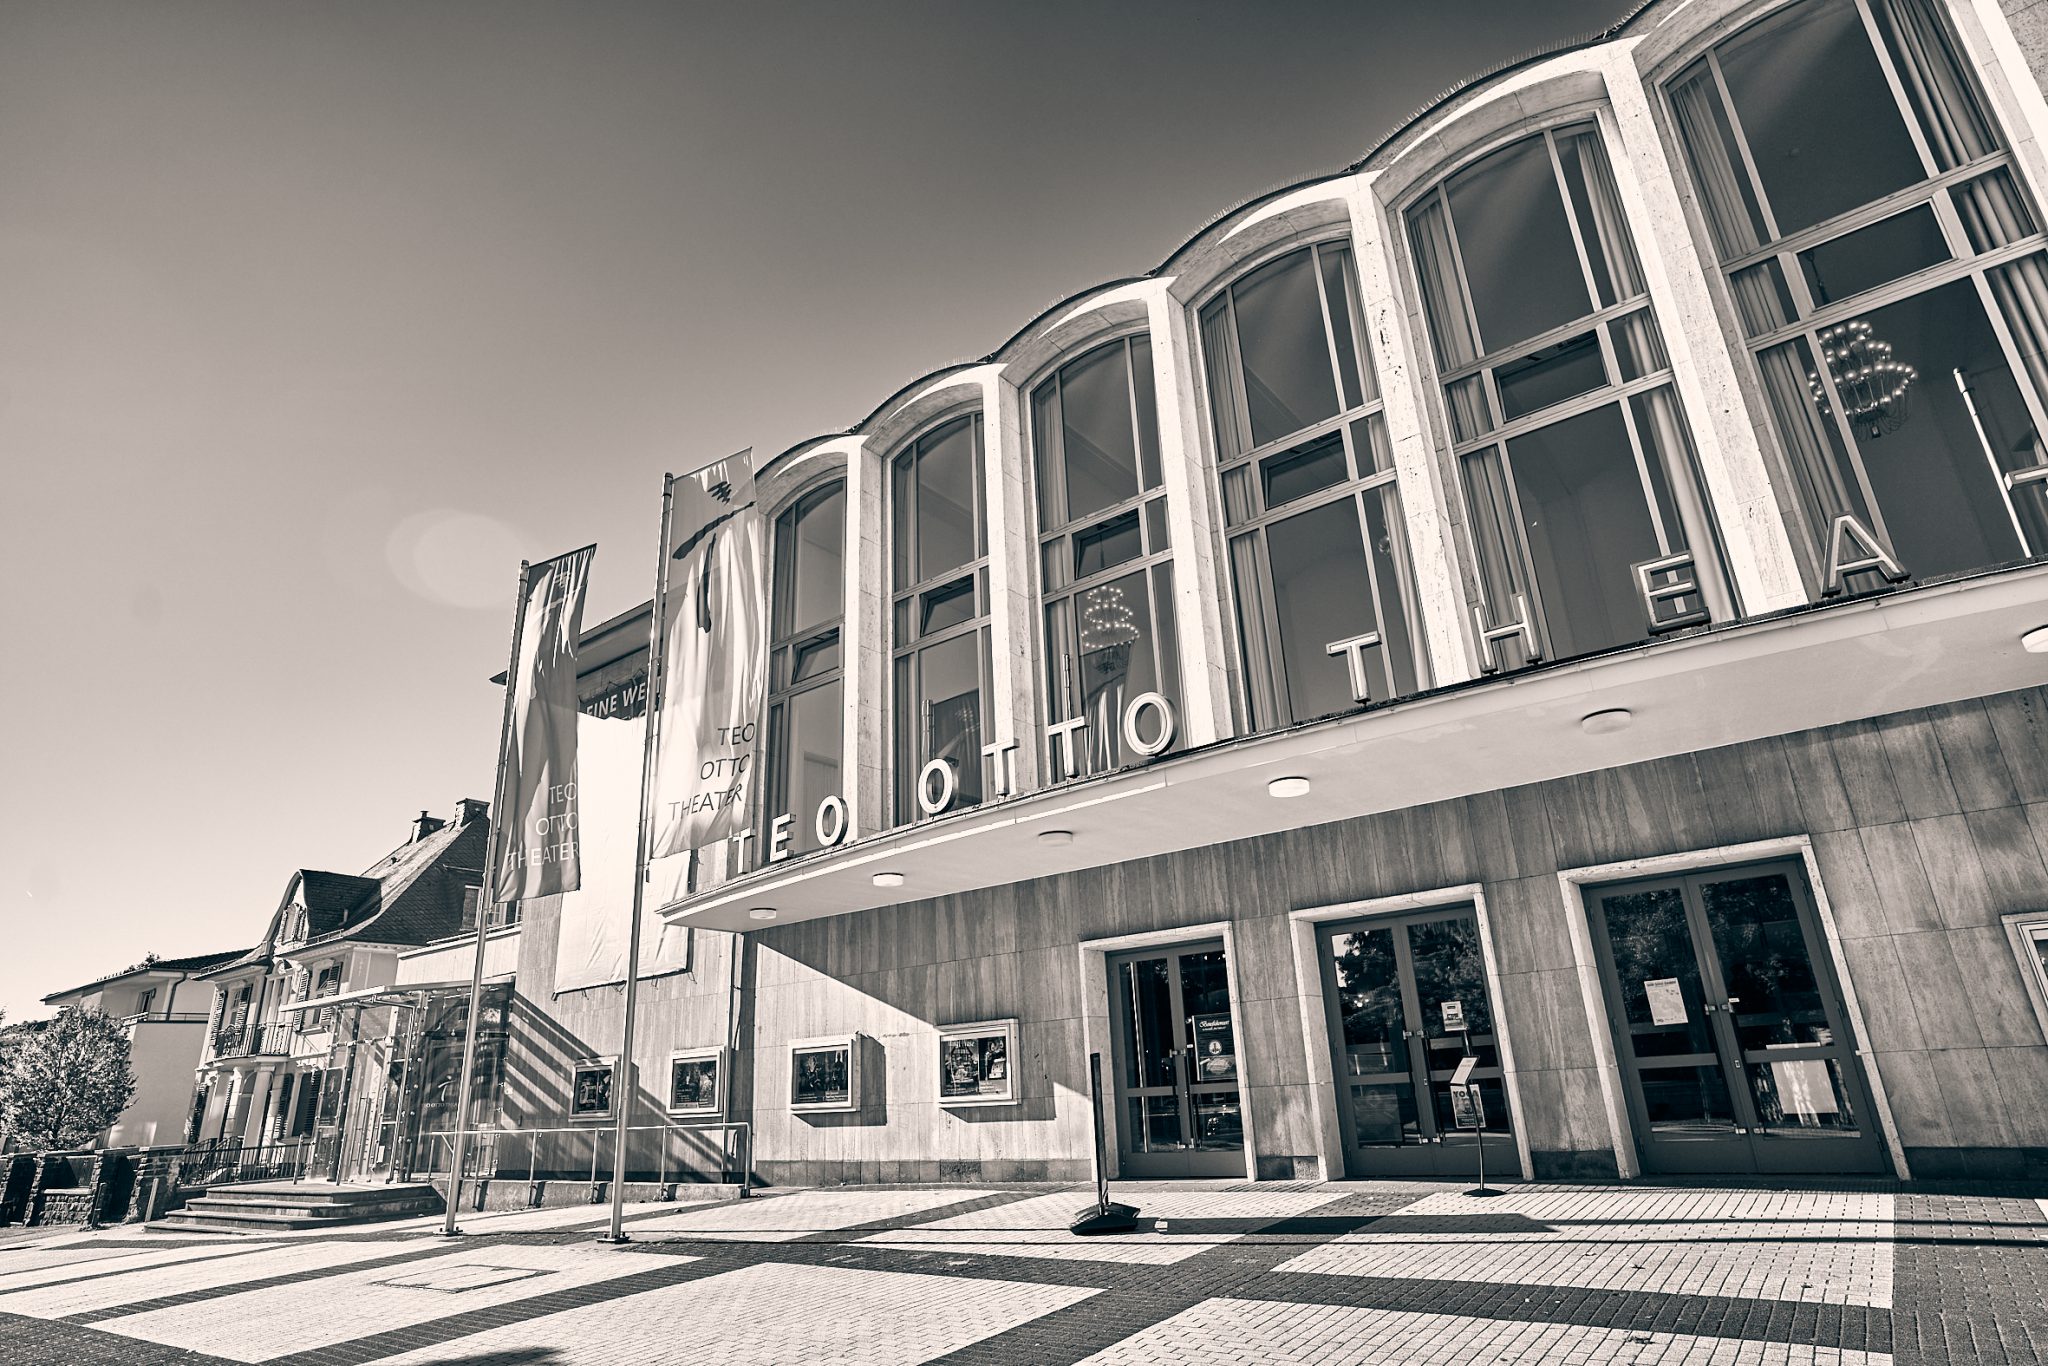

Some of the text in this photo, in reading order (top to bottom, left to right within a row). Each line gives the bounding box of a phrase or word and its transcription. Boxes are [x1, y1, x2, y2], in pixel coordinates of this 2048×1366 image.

[717, 722, 755, 746] TEO
[549, 782, 577, 804] TEO
[732, 795, 849, 875] TEO
[917, 691, 1178, 815] OTTO
[667, 783, 743, 821] THEATER
[535, 812, 578, 836] OTTO
[507, 841, 579, 870] THEATER
[1452, 1089, 1479, 1098] YOA
